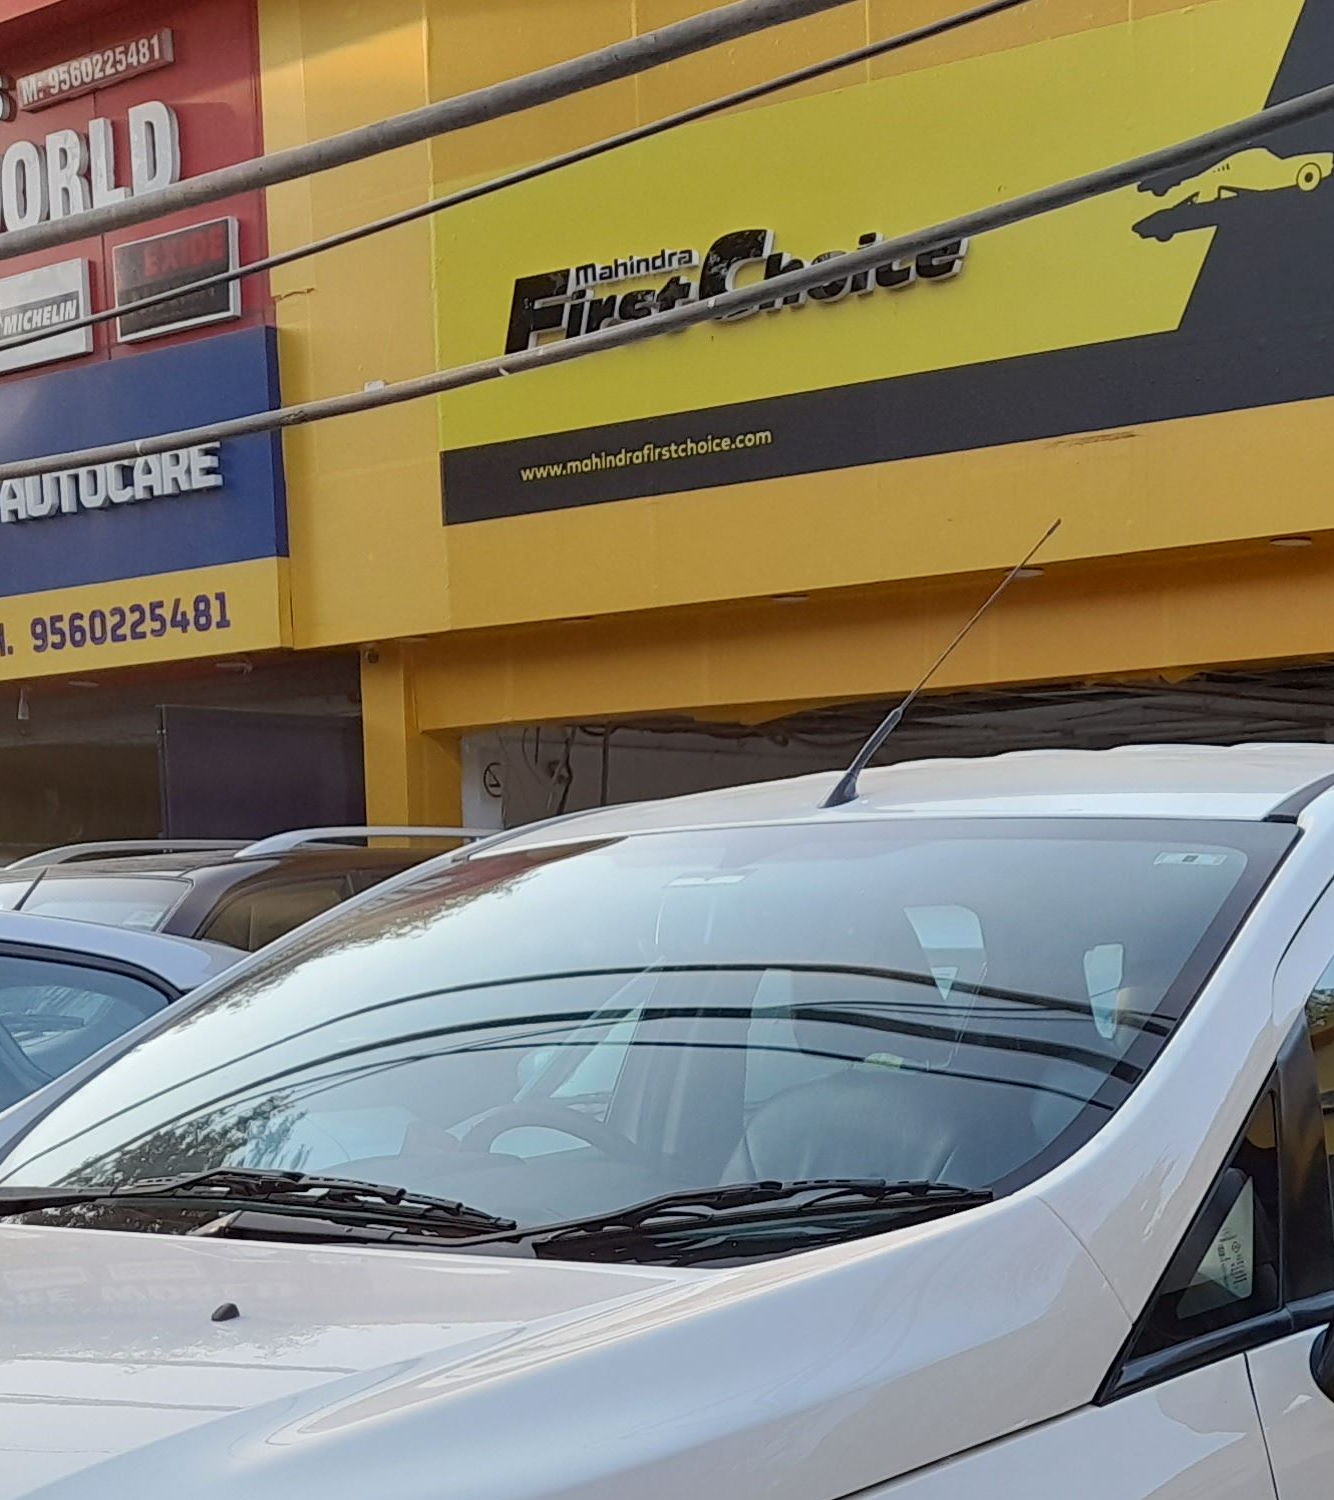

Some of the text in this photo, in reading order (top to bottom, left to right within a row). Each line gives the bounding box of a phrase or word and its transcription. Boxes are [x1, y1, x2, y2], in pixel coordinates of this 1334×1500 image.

[49, 33, 162, 96] 9560225481
[575, 247, 695, 287] Mahindra
[2, 299, 78, 336] MICHELIN
[0, 441, 223, 523] AUTOCARE
[520, 429, 773, 482] www.mahindrafirstchoice.com
[31, 592, 231, 653] 9560225481
